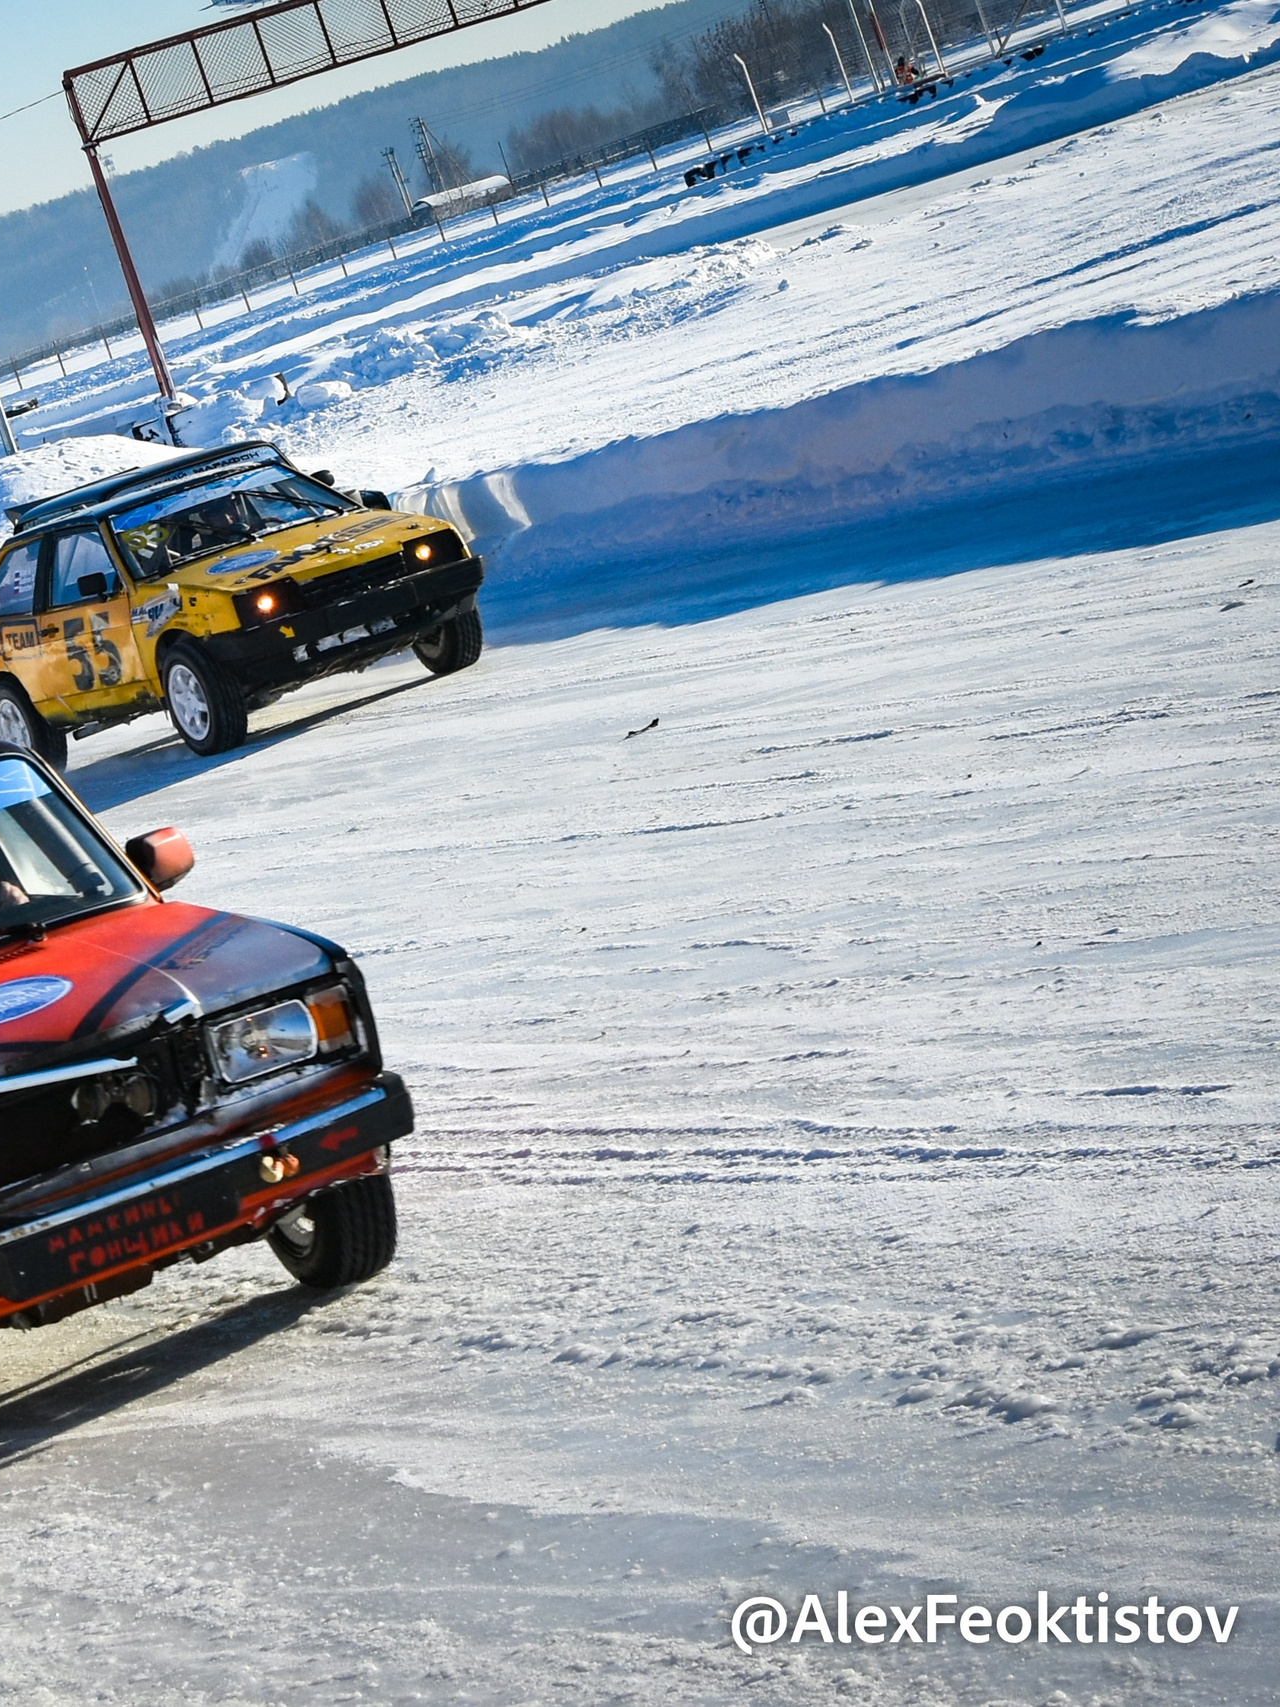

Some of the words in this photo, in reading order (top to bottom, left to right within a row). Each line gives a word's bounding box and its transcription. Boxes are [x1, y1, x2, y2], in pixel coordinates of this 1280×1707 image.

[193, 451, 260, 474] МАРАФОН
[5, 631, 35, 651] TEAM
[63, 611, 122, 691] 55
